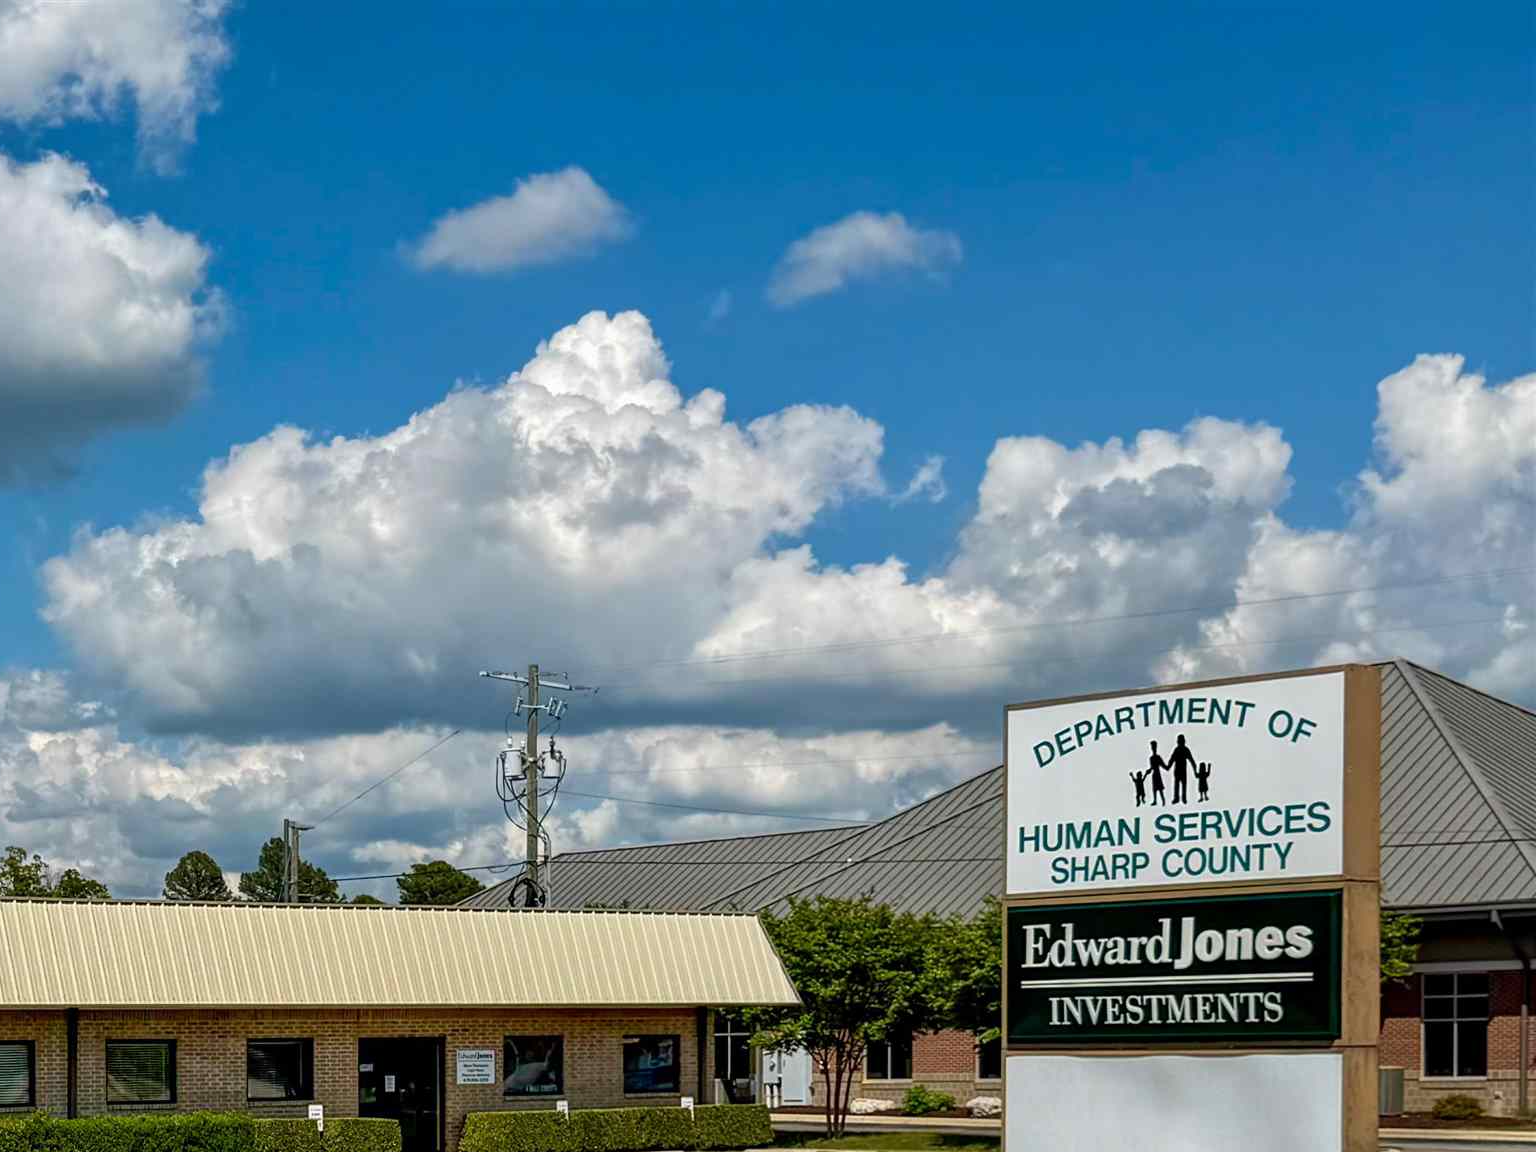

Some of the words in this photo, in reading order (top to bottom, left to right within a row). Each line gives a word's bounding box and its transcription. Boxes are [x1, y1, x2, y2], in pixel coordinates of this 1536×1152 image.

[1033, 698, 1256, 768] DEPARTMENT
[1268, 710, 1317, 743] OF
[1020, 818, 1140, 852] HUMAN
[1154, 801, 1331, 844] SERVICES
[1051, 852, 1150, 884] SHARP
[1162, 841, 1294, 876] COUNTY
[1049, 992, 1284, 1026] INVESTMENTS
